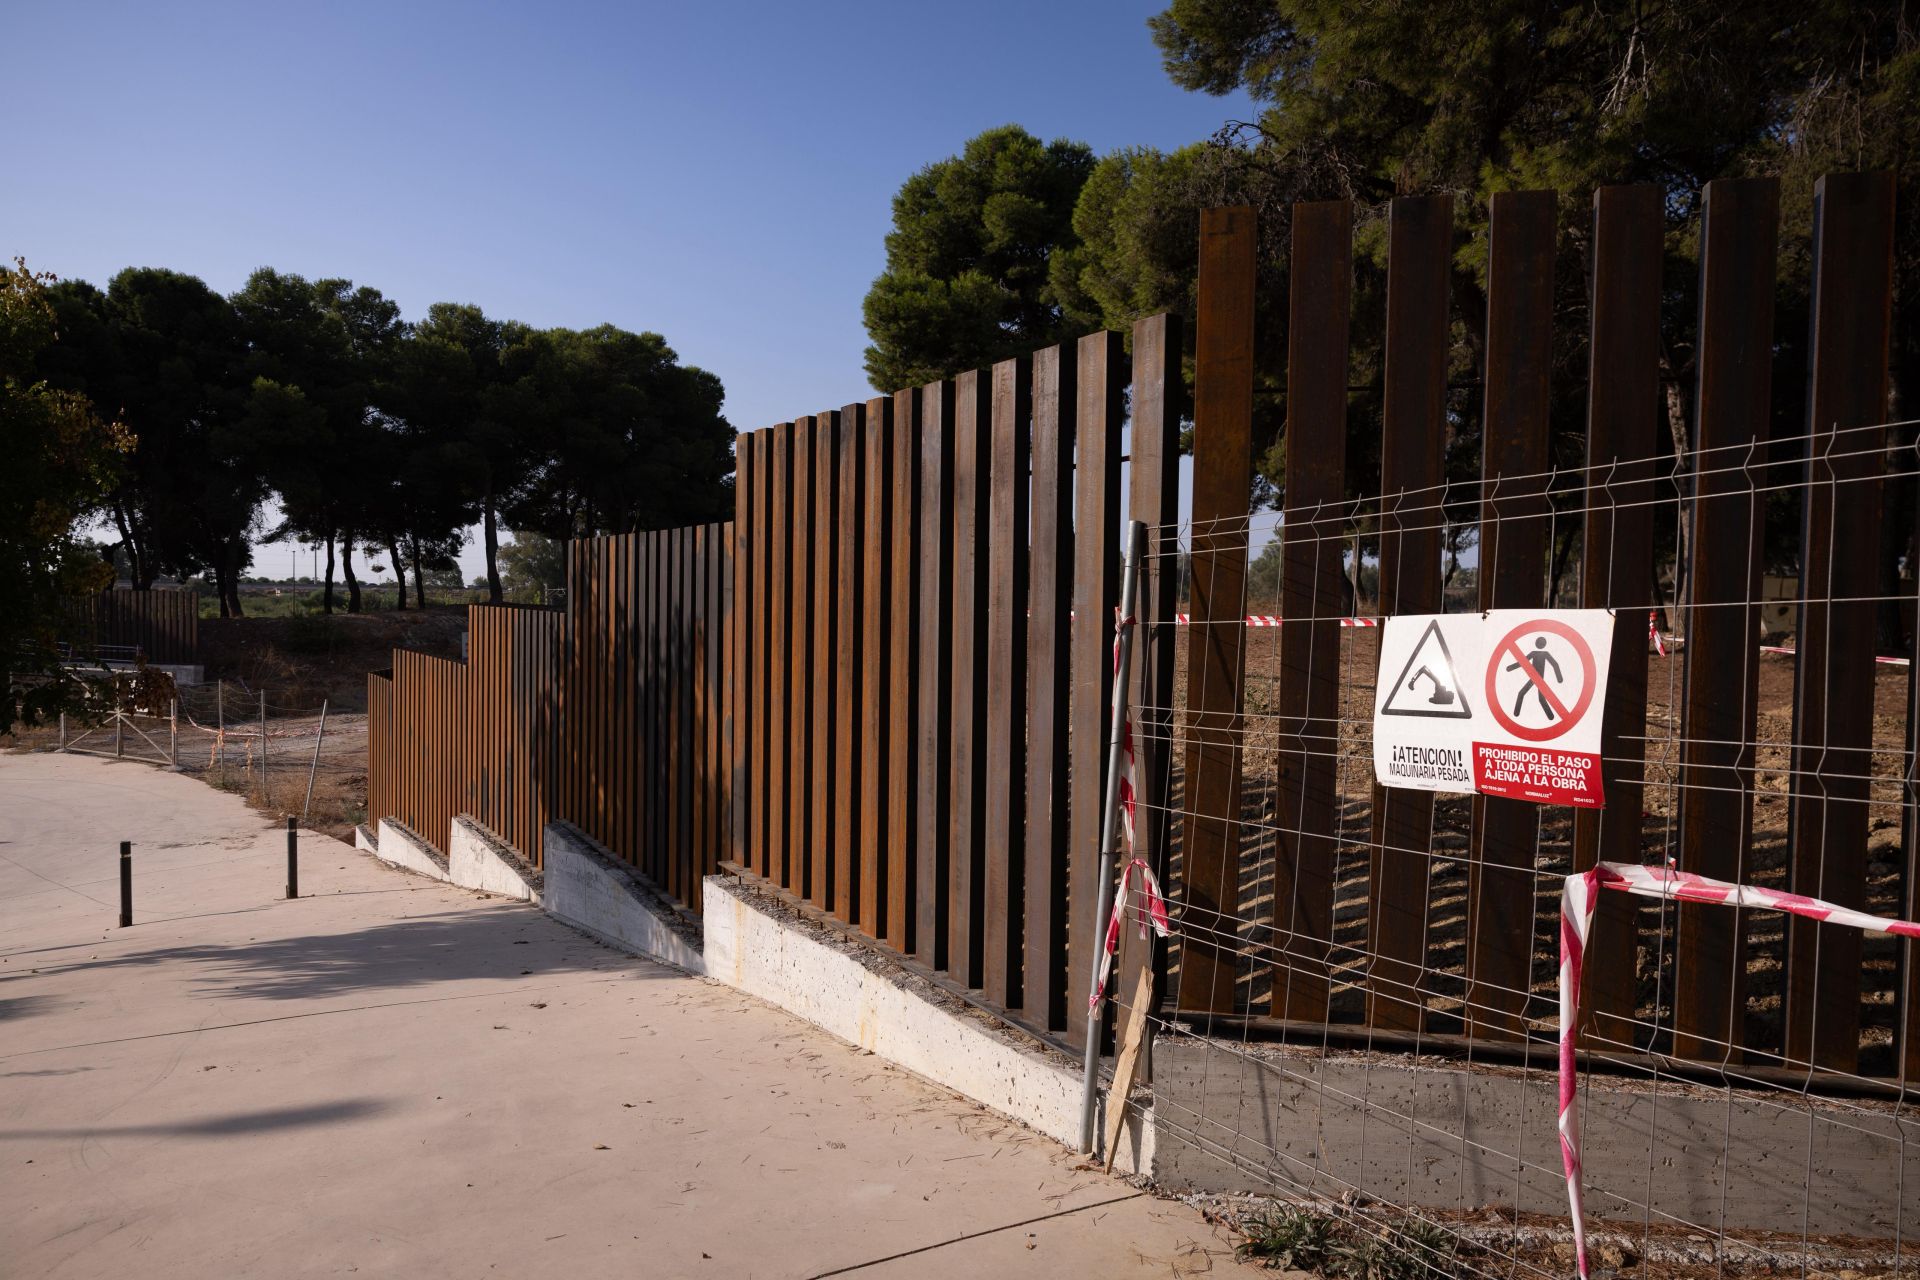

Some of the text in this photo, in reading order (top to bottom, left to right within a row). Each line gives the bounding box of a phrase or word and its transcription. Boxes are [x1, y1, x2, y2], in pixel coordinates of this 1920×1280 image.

[1479, 747, 1592, 769] PROHIBIDO EL PASO
[1485, 758, 1586, 780] A TODA PERSONA
[1389, 763, 1470, 782] MAQUINARIA PESADA
[1485, 769, 1587, 791] AJENA A LA OBRA
